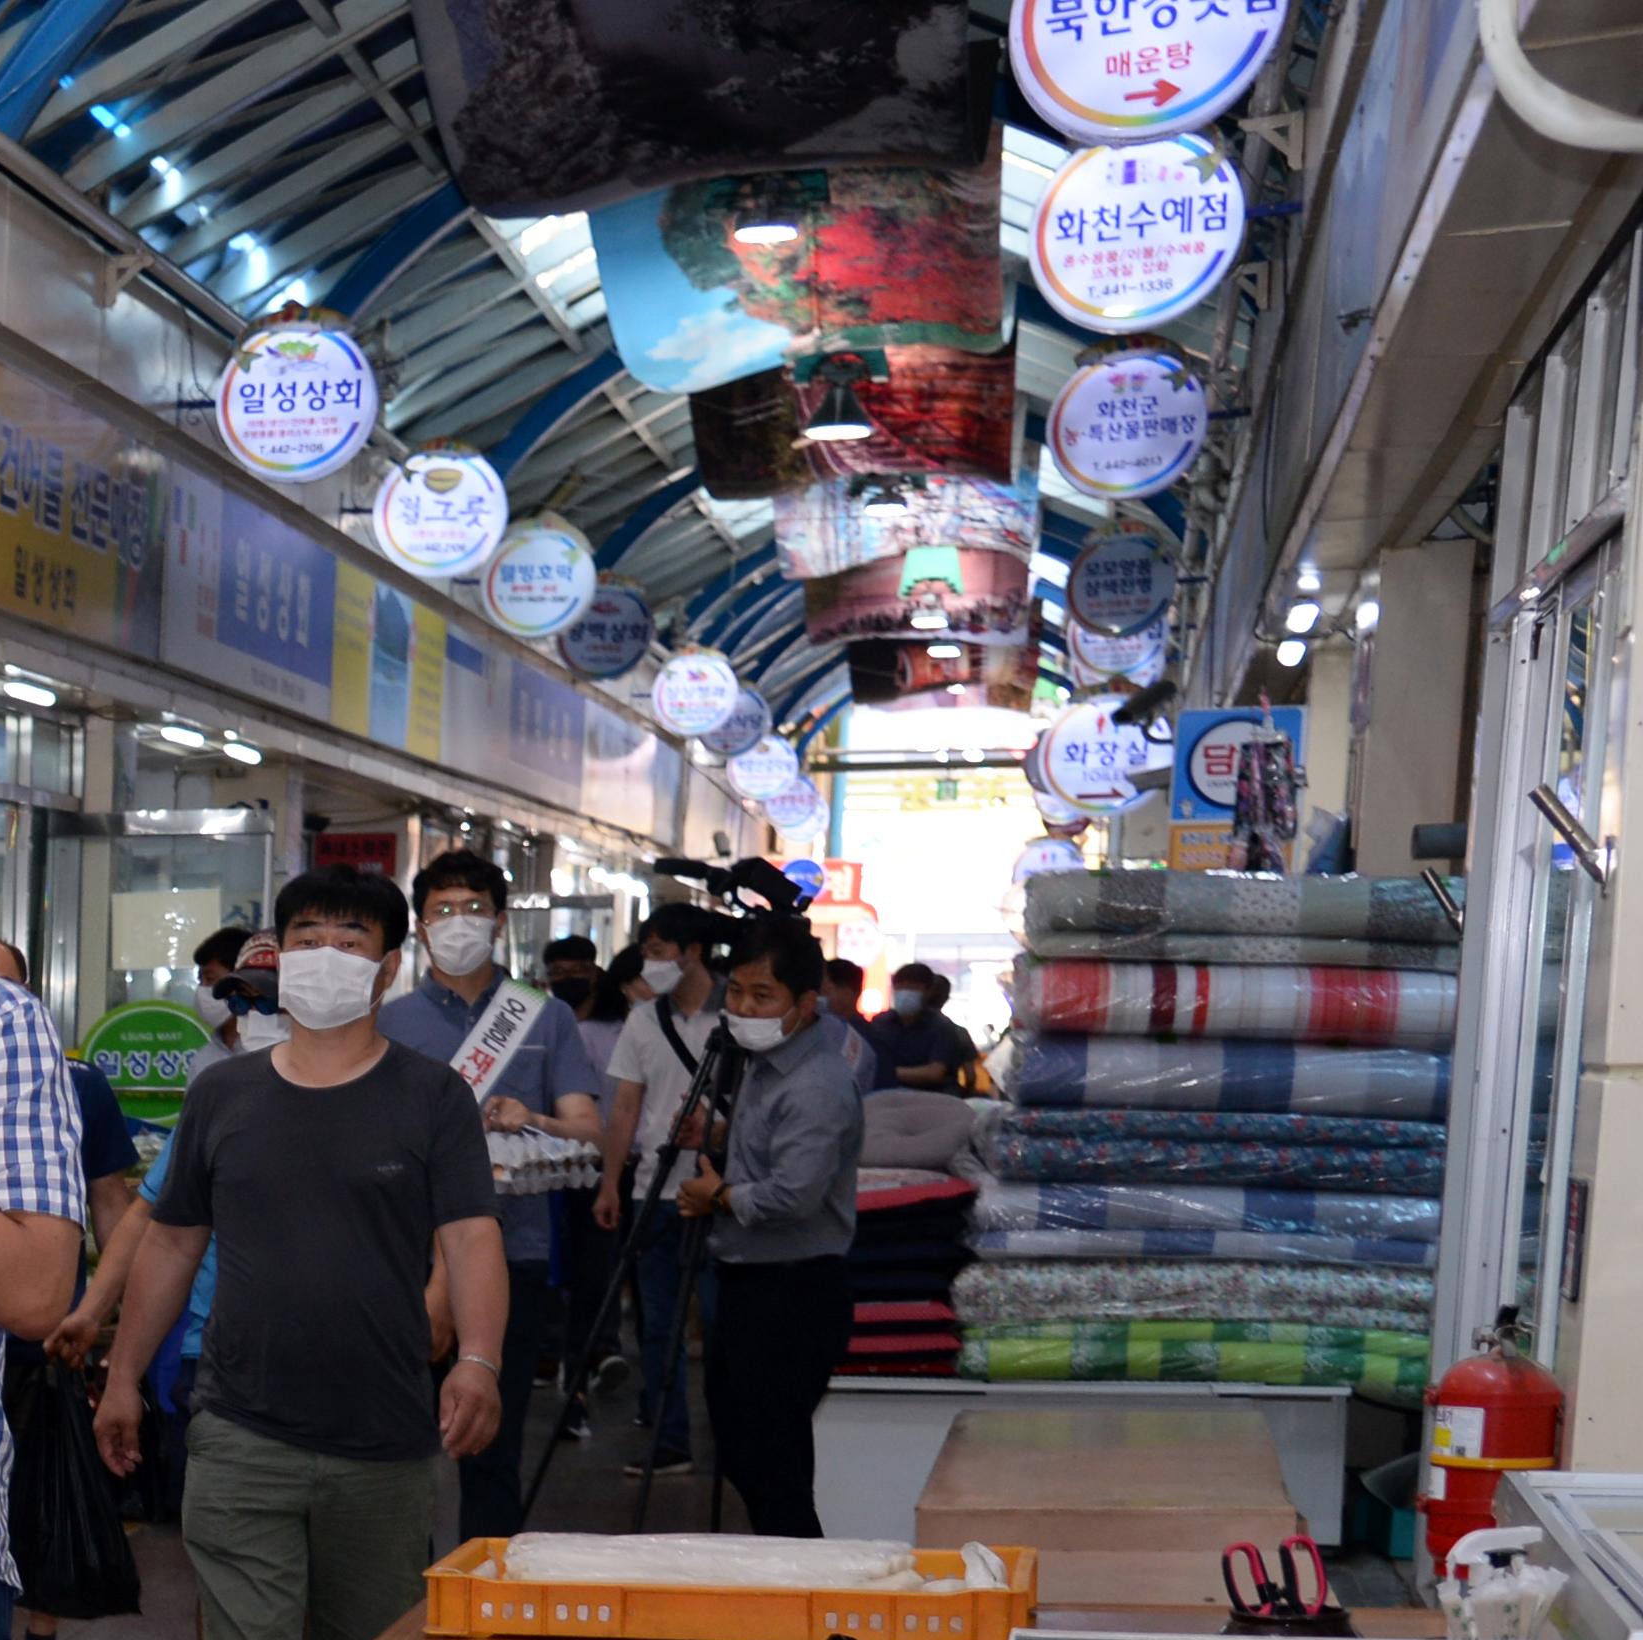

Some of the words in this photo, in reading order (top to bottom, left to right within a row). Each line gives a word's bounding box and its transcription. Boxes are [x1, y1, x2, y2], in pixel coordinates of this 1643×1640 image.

[1105, 41, 1195, 77] 매운탕
[1055, 191, 1229, 246] 화천수예점
[239, 378, 363, 415] 일성상회
[1064, 740, 1150, 766] 화장실
